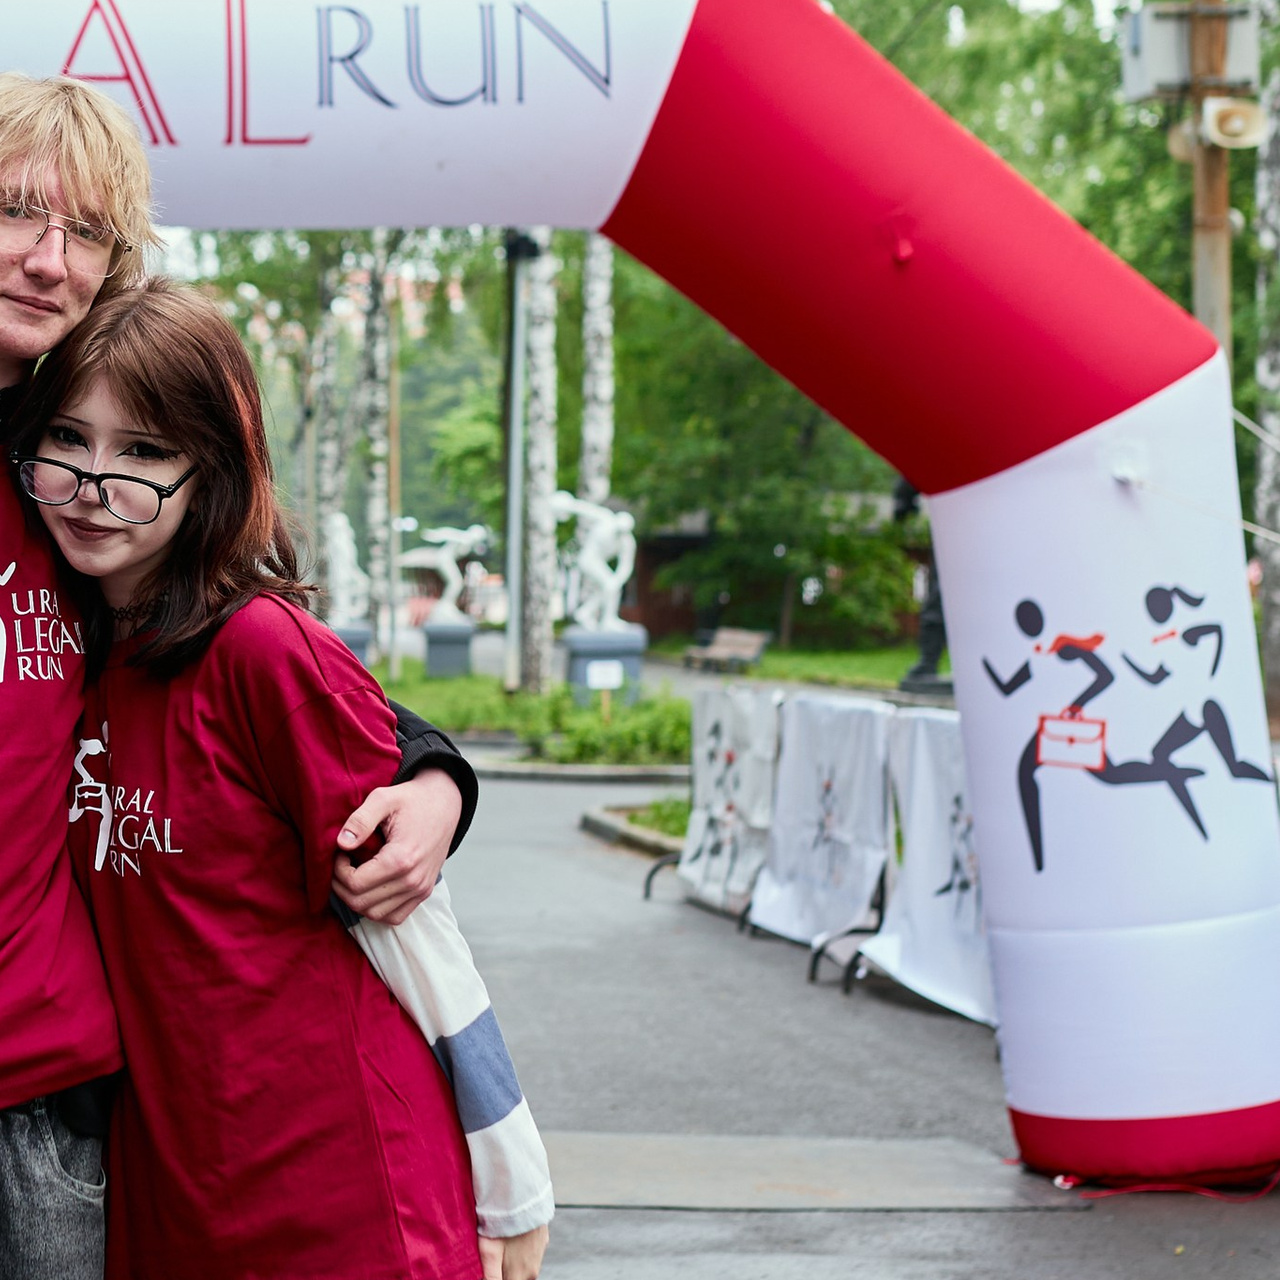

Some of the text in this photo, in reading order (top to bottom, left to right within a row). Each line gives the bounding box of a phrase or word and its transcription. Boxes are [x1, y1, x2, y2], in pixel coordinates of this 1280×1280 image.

[317, 0, 612, 110] RUN
[11, 588, 61, 618] URA
[17, 654, 64, 680] RUN
[111, 785, 155, 814] RAL
